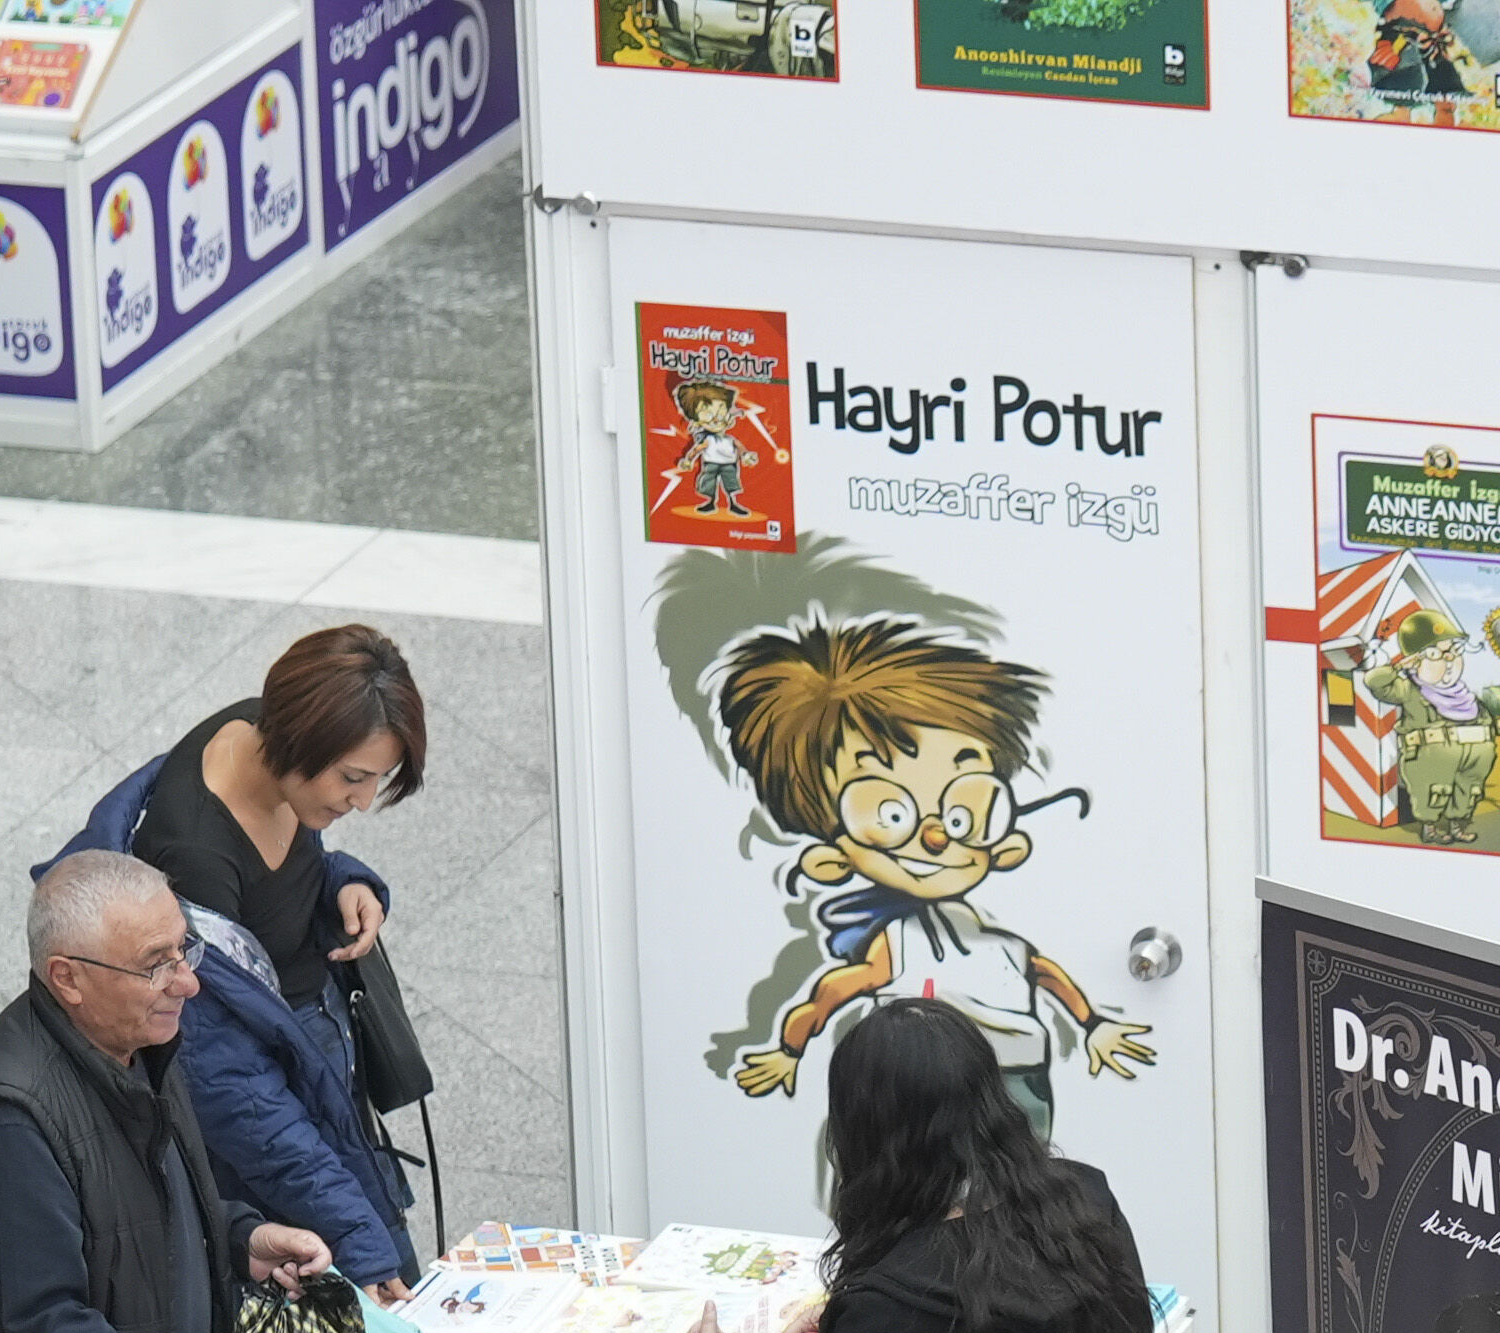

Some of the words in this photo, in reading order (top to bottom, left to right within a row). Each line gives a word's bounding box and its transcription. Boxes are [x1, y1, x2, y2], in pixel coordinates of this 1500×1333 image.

[934, 45, 1048, 68] Anooshirvan
[1052, 54, 1123, 76] Miandji
[662, 326, 724, 343] muzaffer
[649, 340, 709, 378] Hayri
[714, 345, 779, 379] Potur
[805, 361, 967, 455] Hayri
[993, 375, 1162, 458] Potur
[1373, 475, 1460, 499] Muzaffer
[848, 472, 1056, 525] muzaffer
[1064, 481, 1159, 541] izgü
[1366, 516, 1440, 538] ASKERE
[1332, 1007, 1409, 1090] Dr.
